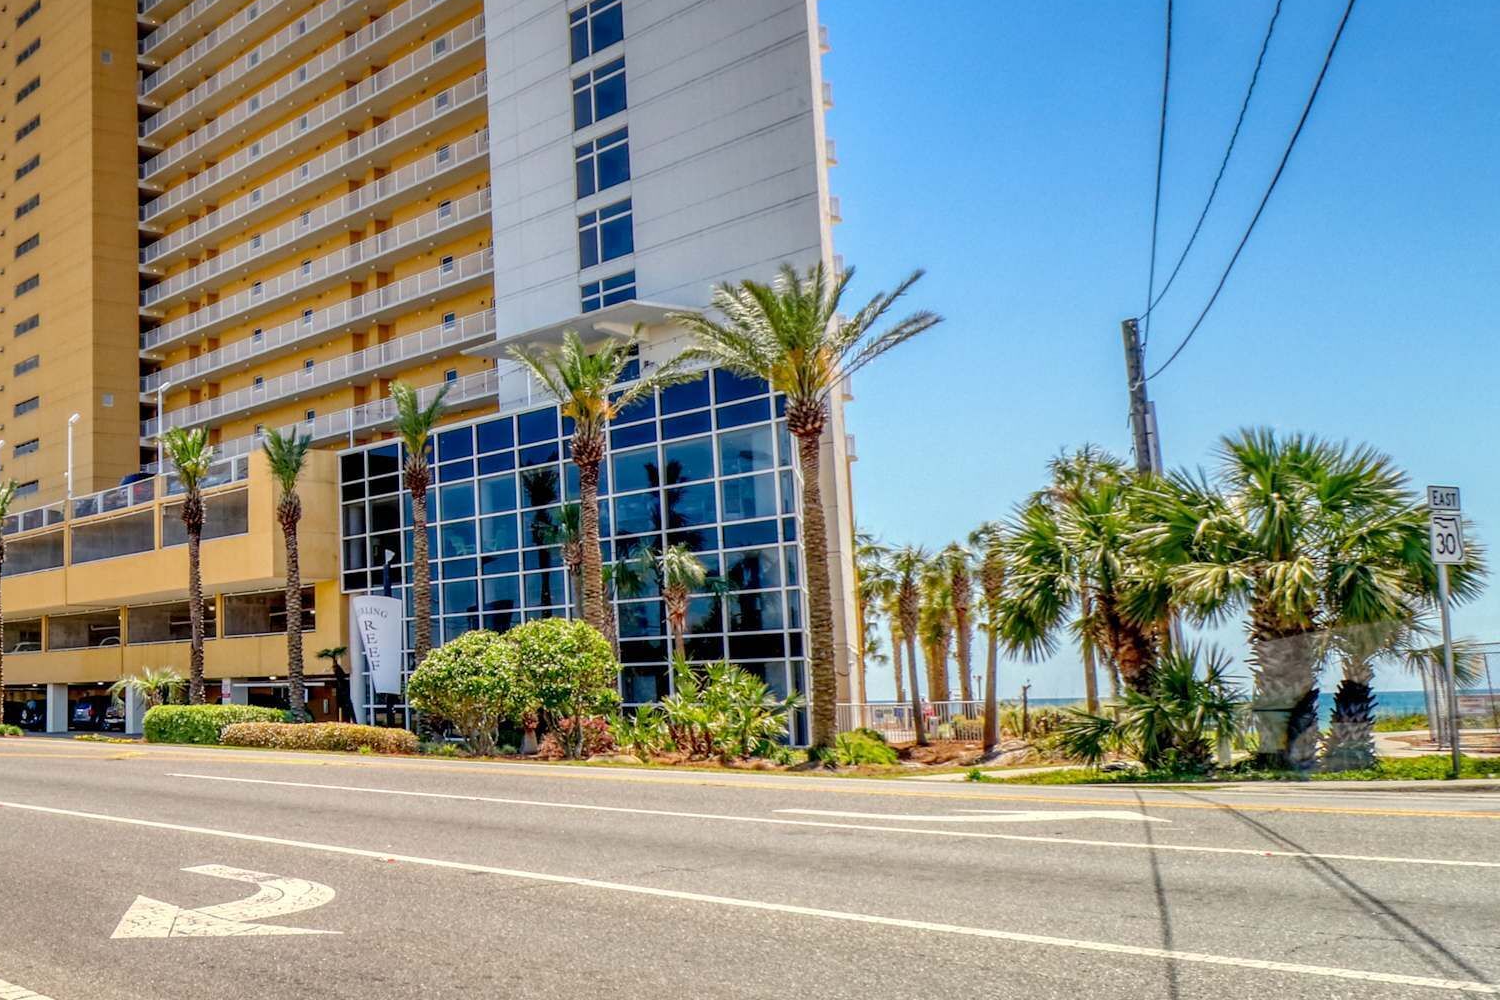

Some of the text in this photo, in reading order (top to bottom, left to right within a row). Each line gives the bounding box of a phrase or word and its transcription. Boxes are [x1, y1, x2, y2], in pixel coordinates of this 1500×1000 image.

[1432, 490, 1457, 506] EAST
[1436, 533, 1456, 555] 30
[364, 620, 381, 671] REEF
